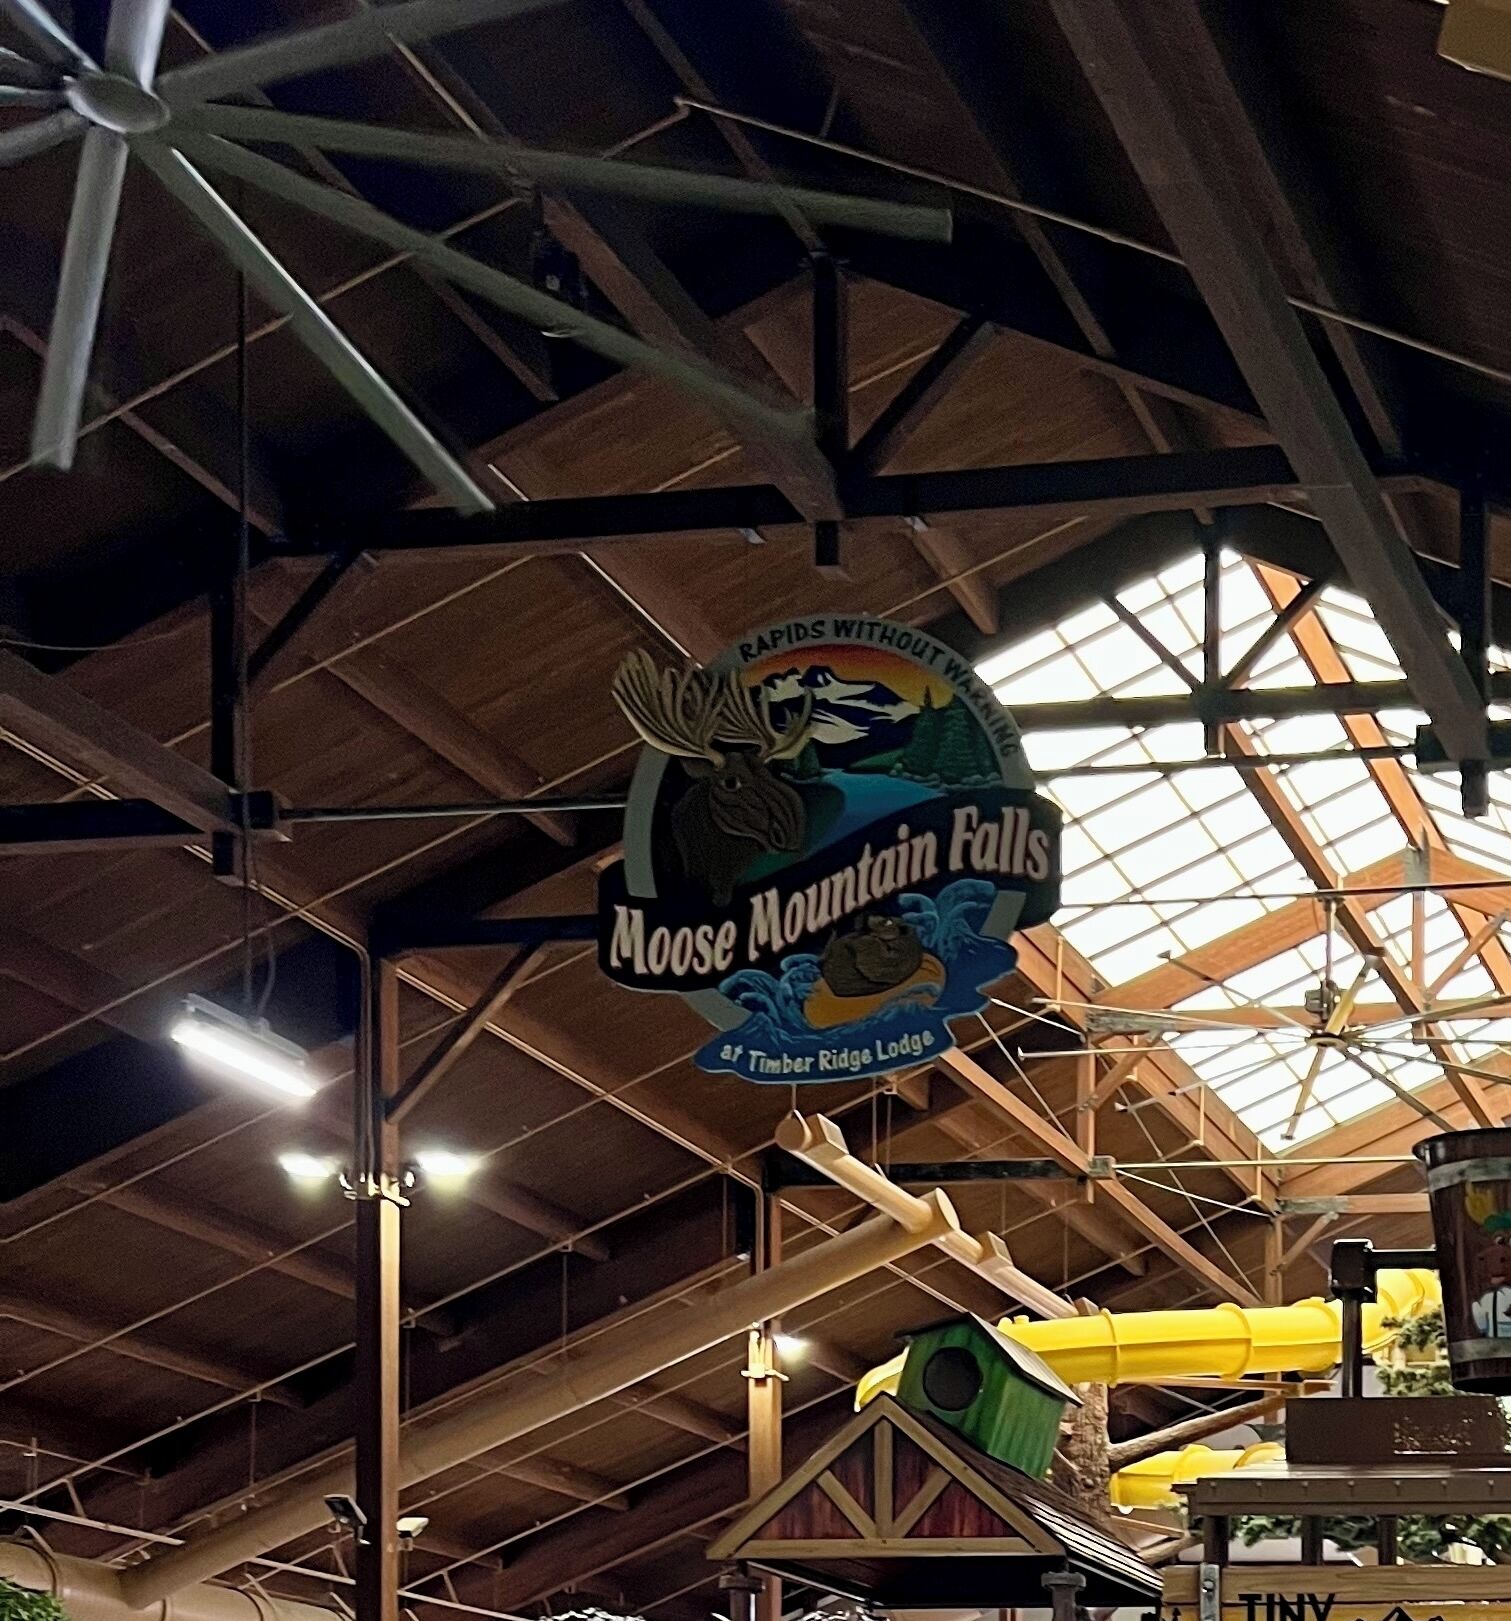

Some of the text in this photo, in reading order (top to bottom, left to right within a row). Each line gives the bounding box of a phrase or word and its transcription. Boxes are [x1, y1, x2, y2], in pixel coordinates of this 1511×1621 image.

[739, 618, 1022, 758] RAPIDS WITHOUT WARNING
[610, 805, 1051, 977] Moose Mountain Falls
[719, 1028, 935, 1075] at Timber Ridge Lodge
